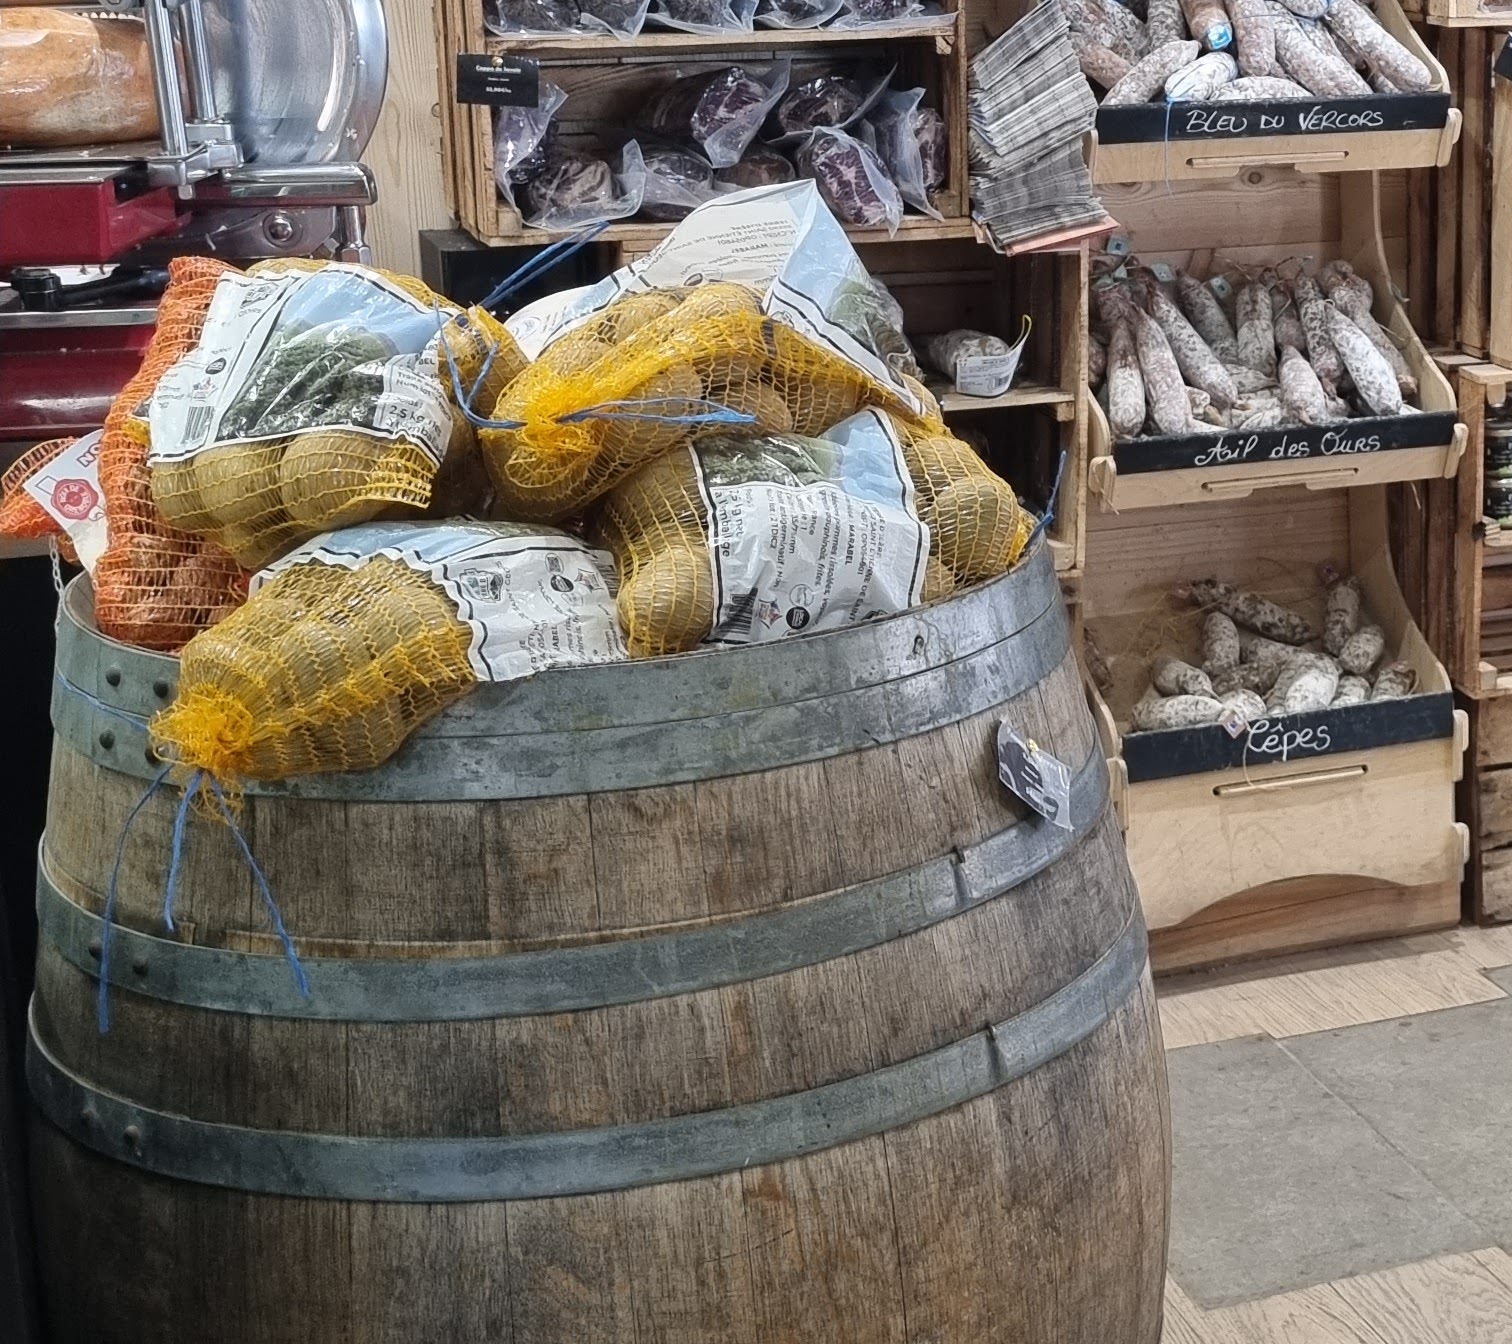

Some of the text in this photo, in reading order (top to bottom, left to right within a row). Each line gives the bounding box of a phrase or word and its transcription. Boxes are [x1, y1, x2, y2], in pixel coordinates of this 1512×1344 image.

[1186, 107, 1384, 135] BLEU DU VERCORS
[1268, 435, 1310, 459] des
[845, 524, 855, 565] MARABEL
